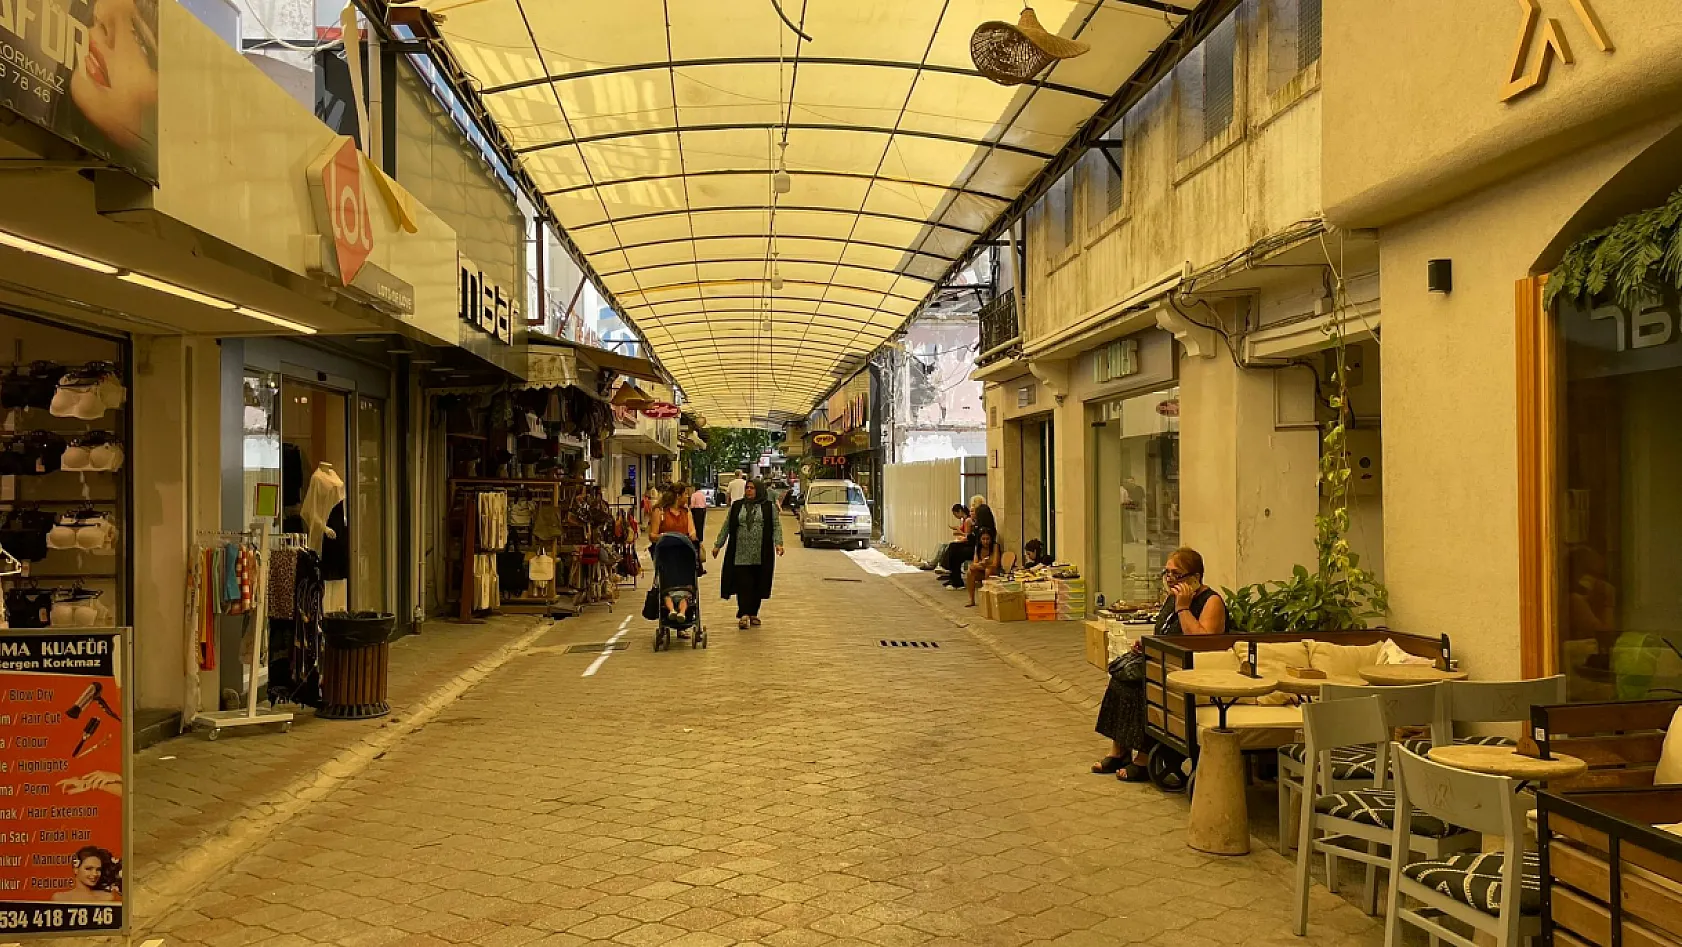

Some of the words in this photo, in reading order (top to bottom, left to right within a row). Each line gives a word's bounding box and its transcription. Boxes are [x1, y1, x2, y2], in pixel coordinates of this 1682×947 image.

[12, 70, 29, 91] 78
[33, 86, 51, 103] 46
[822, 456, 846, 466] FLO
[0, 641, 31, 657] MA
[41, 637, 108, 656] KUAFÖR
[0, 660, 39, 671] ergen
[43, 658, 101, 668] Korkmaz
[9, 688, 34, 702] Blow
[37, 687, 54, 703] Dry
[0, 714, 11, 725] m
[21, 712, 41, 725] Hair
[44, 711, 62, 725] Cut
[15, 736, 49, 748] Colour
[0, 761, 8, 773] e
[17, 758, 69, 773] Highlights
[23, 782, 50, 796] Perm
[27, 806, 48, 819] Hair
[50, 805, 98, 819] Extension
[0, 833, 6, 843] n
[39, 829, 68, 843] Bridal
[71, 829, 91, 841] Hair
[32, 852, 77, 866] Manicure
[31, 877, 74, 890] Pedicure
[0, 910, 29, 929] 534
[32, 909, 63, 927] 418
[67, 907, 88, 926] 78
[92, 906, 113, 925] 46
